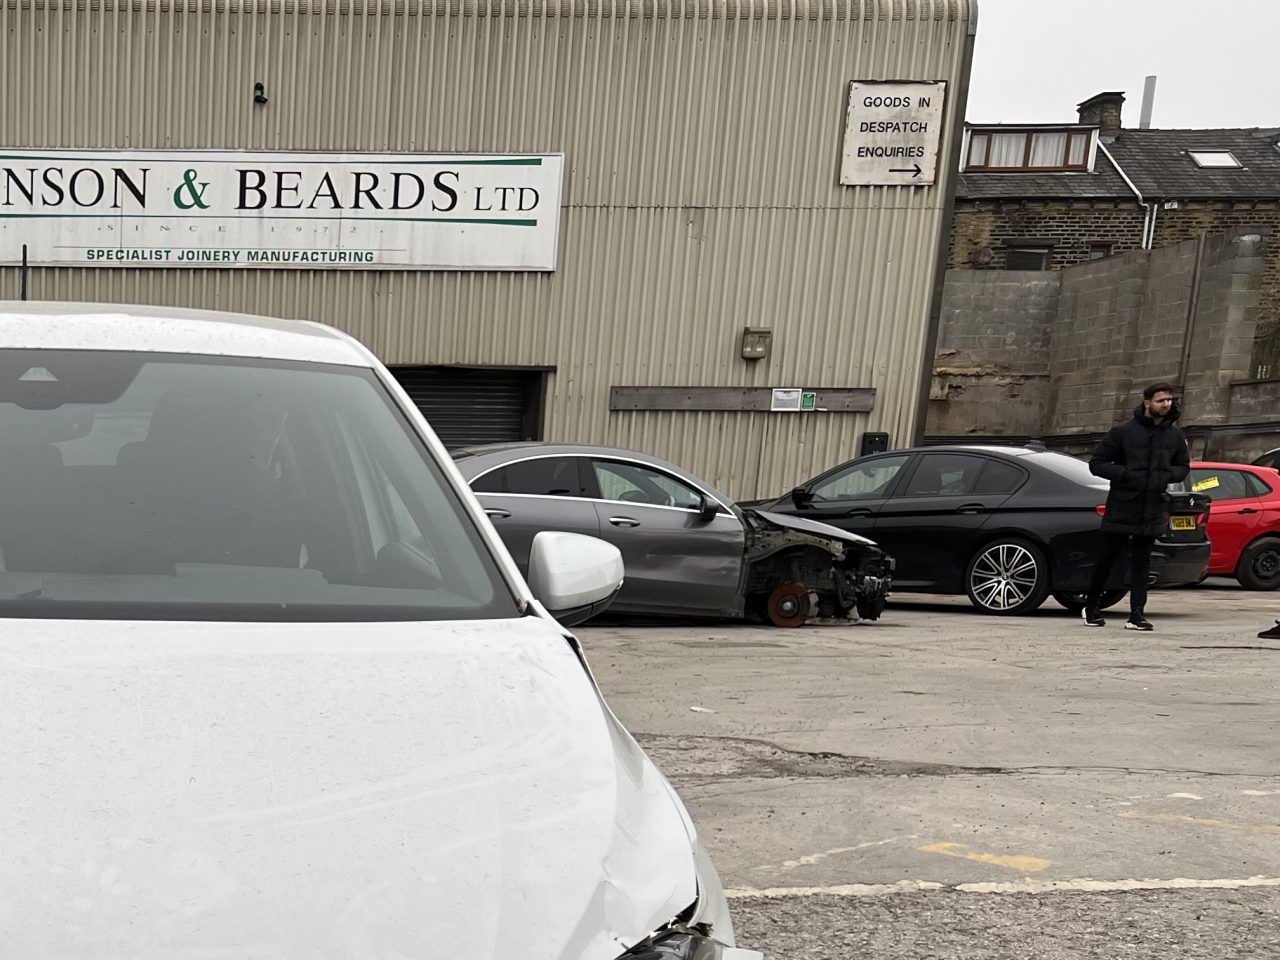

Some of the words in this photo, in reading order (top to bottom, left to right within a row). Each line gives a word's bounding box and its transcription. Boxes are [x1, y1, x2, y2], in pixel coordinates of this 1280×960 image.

[863, 97, 911, 107] GOODS
[918, 97, 930, 107] IN
[860, 122, 927, 132] DESPATCH
[857, 147, 924, 157] ENQUIRIES
[173, 168, 211, 210] &
[234, 168, 461, 212] BEARDS
[473, 186, 540, 212] LTD
[107, 224, 226, 232] SINCE
[270, 225, 357, 234] 1972
[86, 248, 172, 262] SPECIALIST
[177, 249, 240, 263] JOINERY
[247, 250, 374, 263] MANUFACTURING
